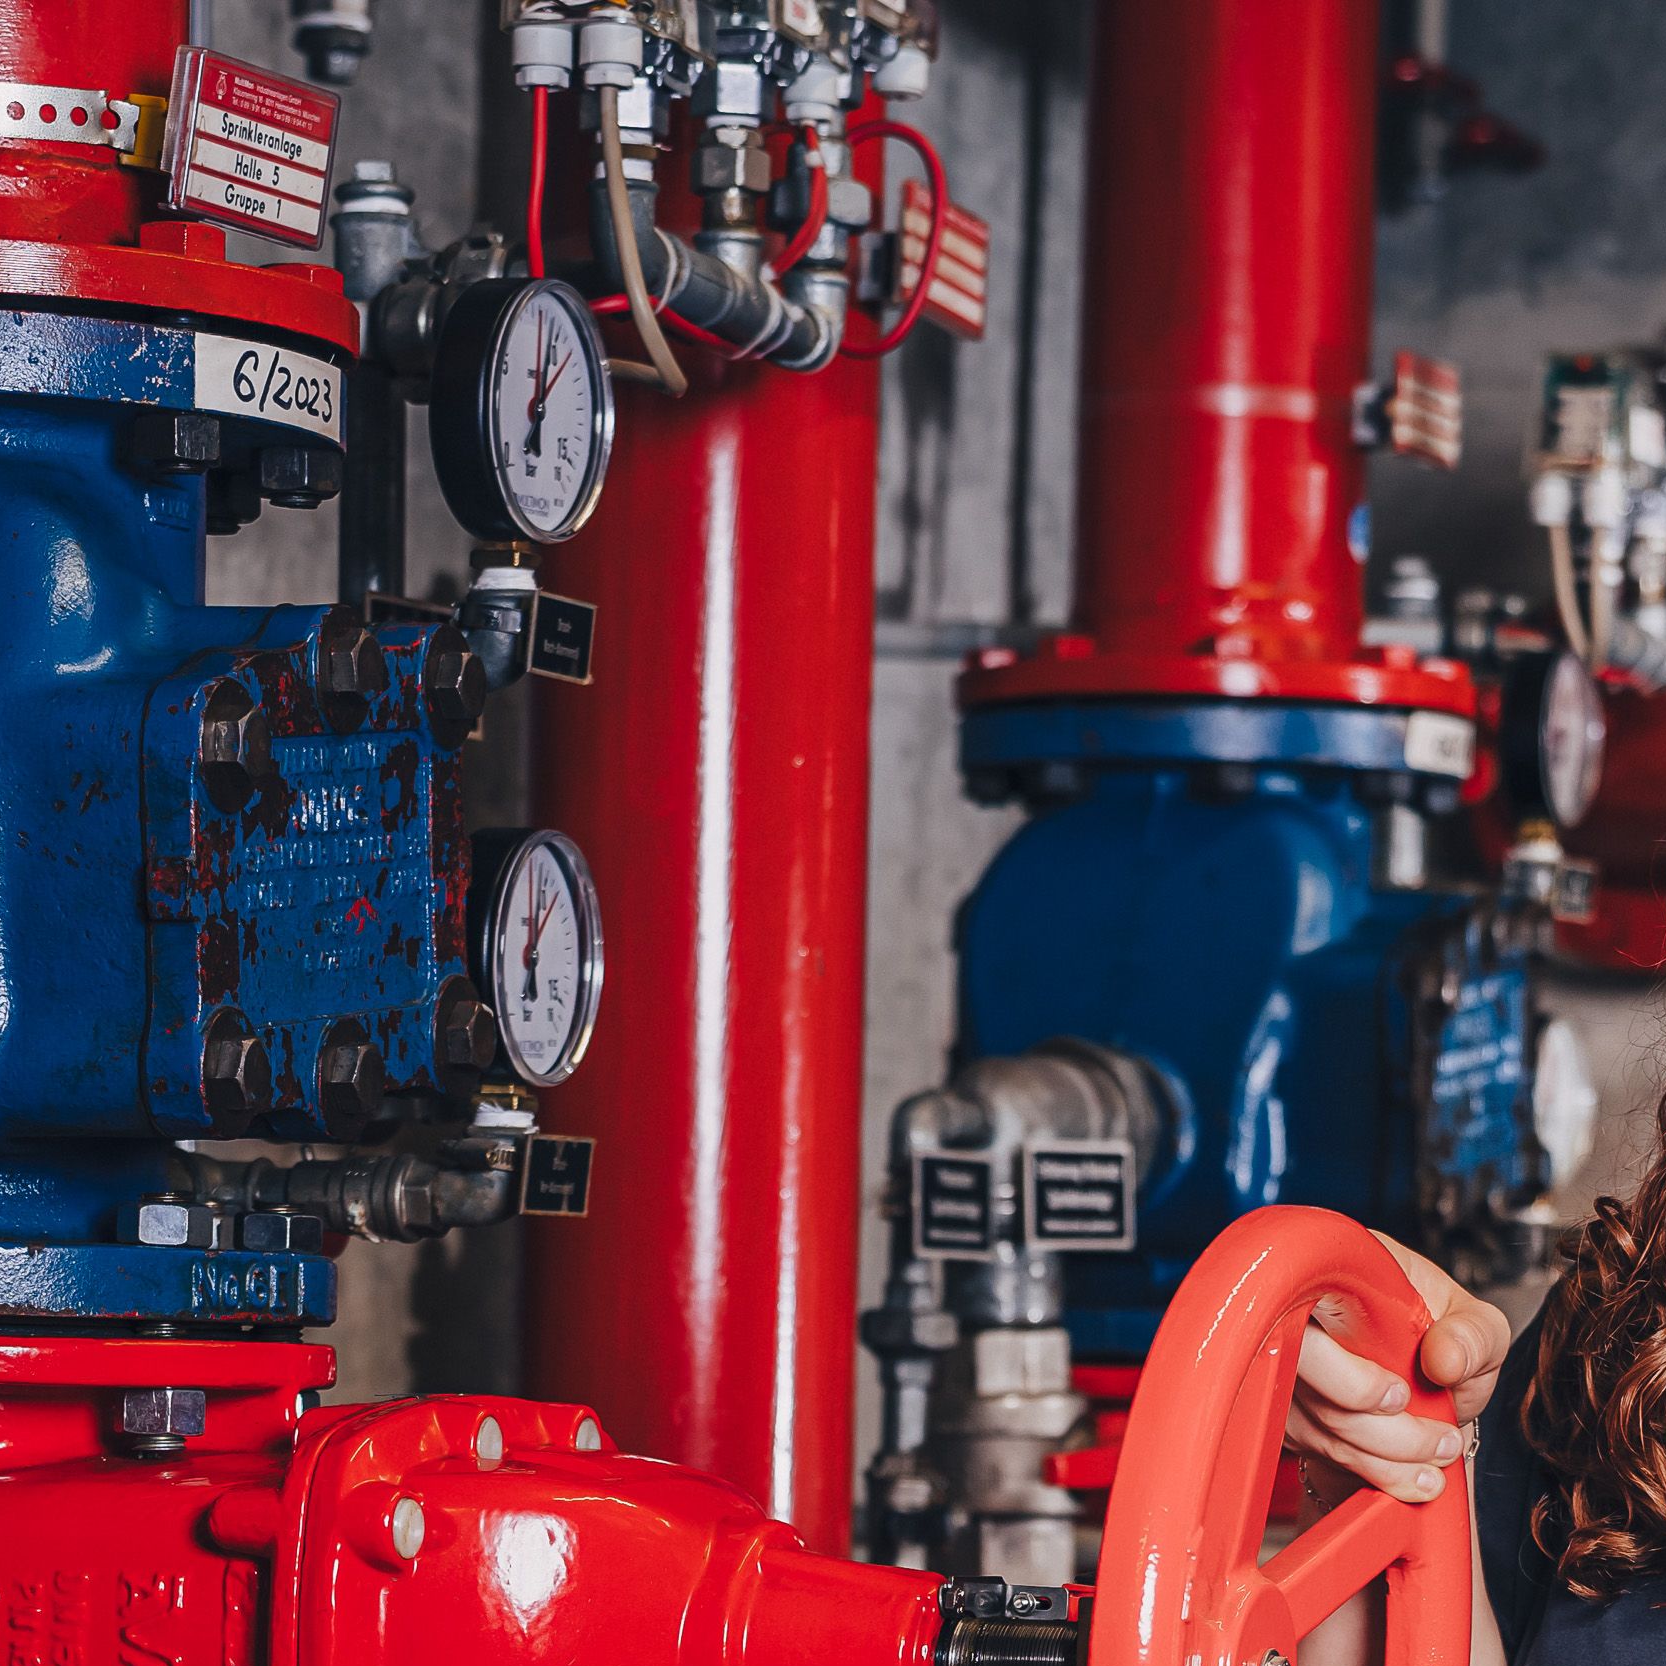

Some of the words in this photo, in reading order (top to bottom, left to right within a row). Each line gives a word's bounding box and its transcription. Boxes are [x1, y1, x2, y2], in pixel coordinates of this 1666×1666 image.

[222, 112, 302, 160] Sprinkleranlage
[235, 154, 262, 181] Halle
[272, 166, 280, 186] 5
[225, 184, 265, 216] Gruppe
[277, 199, 282, 219] 1
[233, 350, 332, 423] 6/2023
